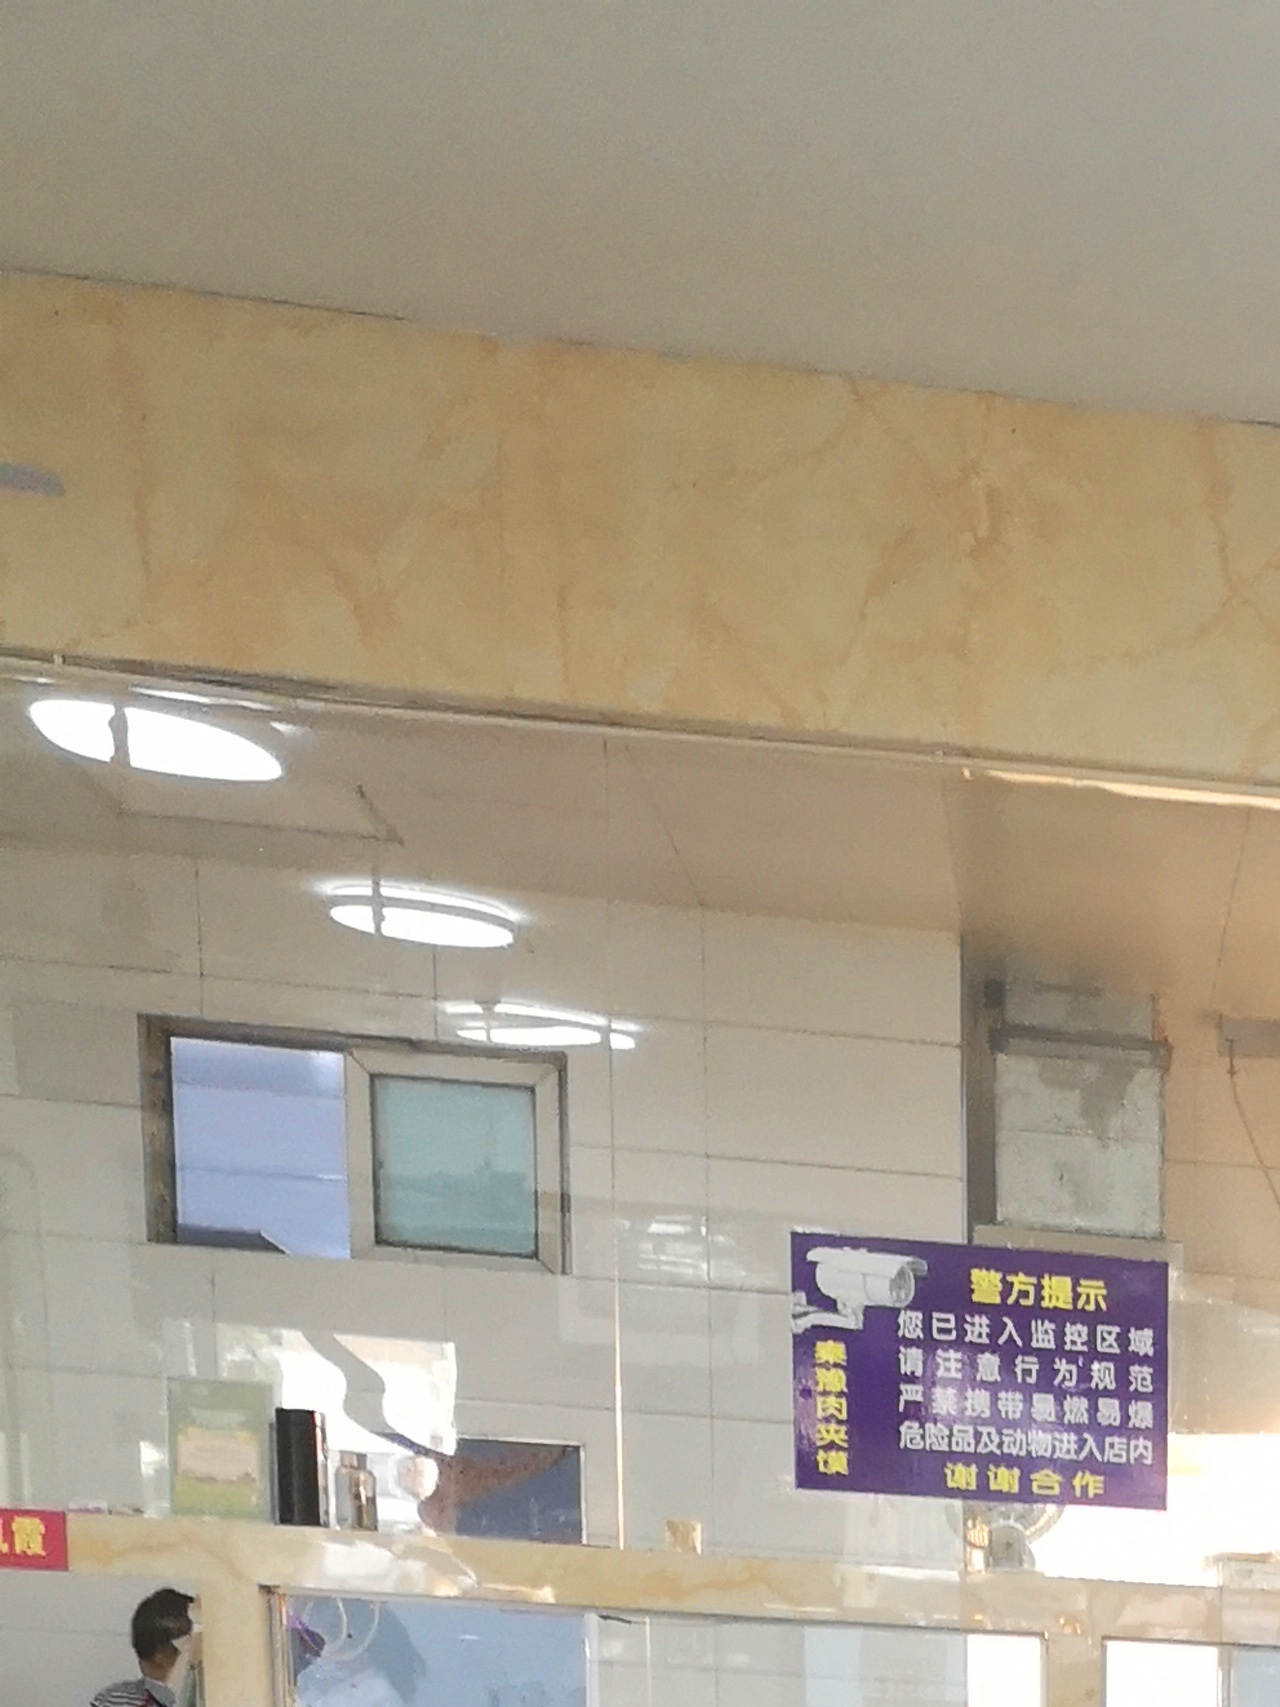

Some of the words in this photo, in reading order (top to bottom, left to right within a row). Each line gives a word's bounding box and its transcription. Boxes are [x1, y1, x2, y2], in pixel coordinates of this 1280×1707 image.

[969, 1267, 1108, 1313] 警方提示
[898, 1309, 1154, 1358] 您已进入监控区域
[898, 1346, 1154, 1394] 请注意行为规范
[898, 1384, 1154, 1431] 严禁携带易燃易爆
[898, 1423, 1154, 1467] 危险品及动物进入店内
[944, 1462, 1106, 1499] 谢谢合作
